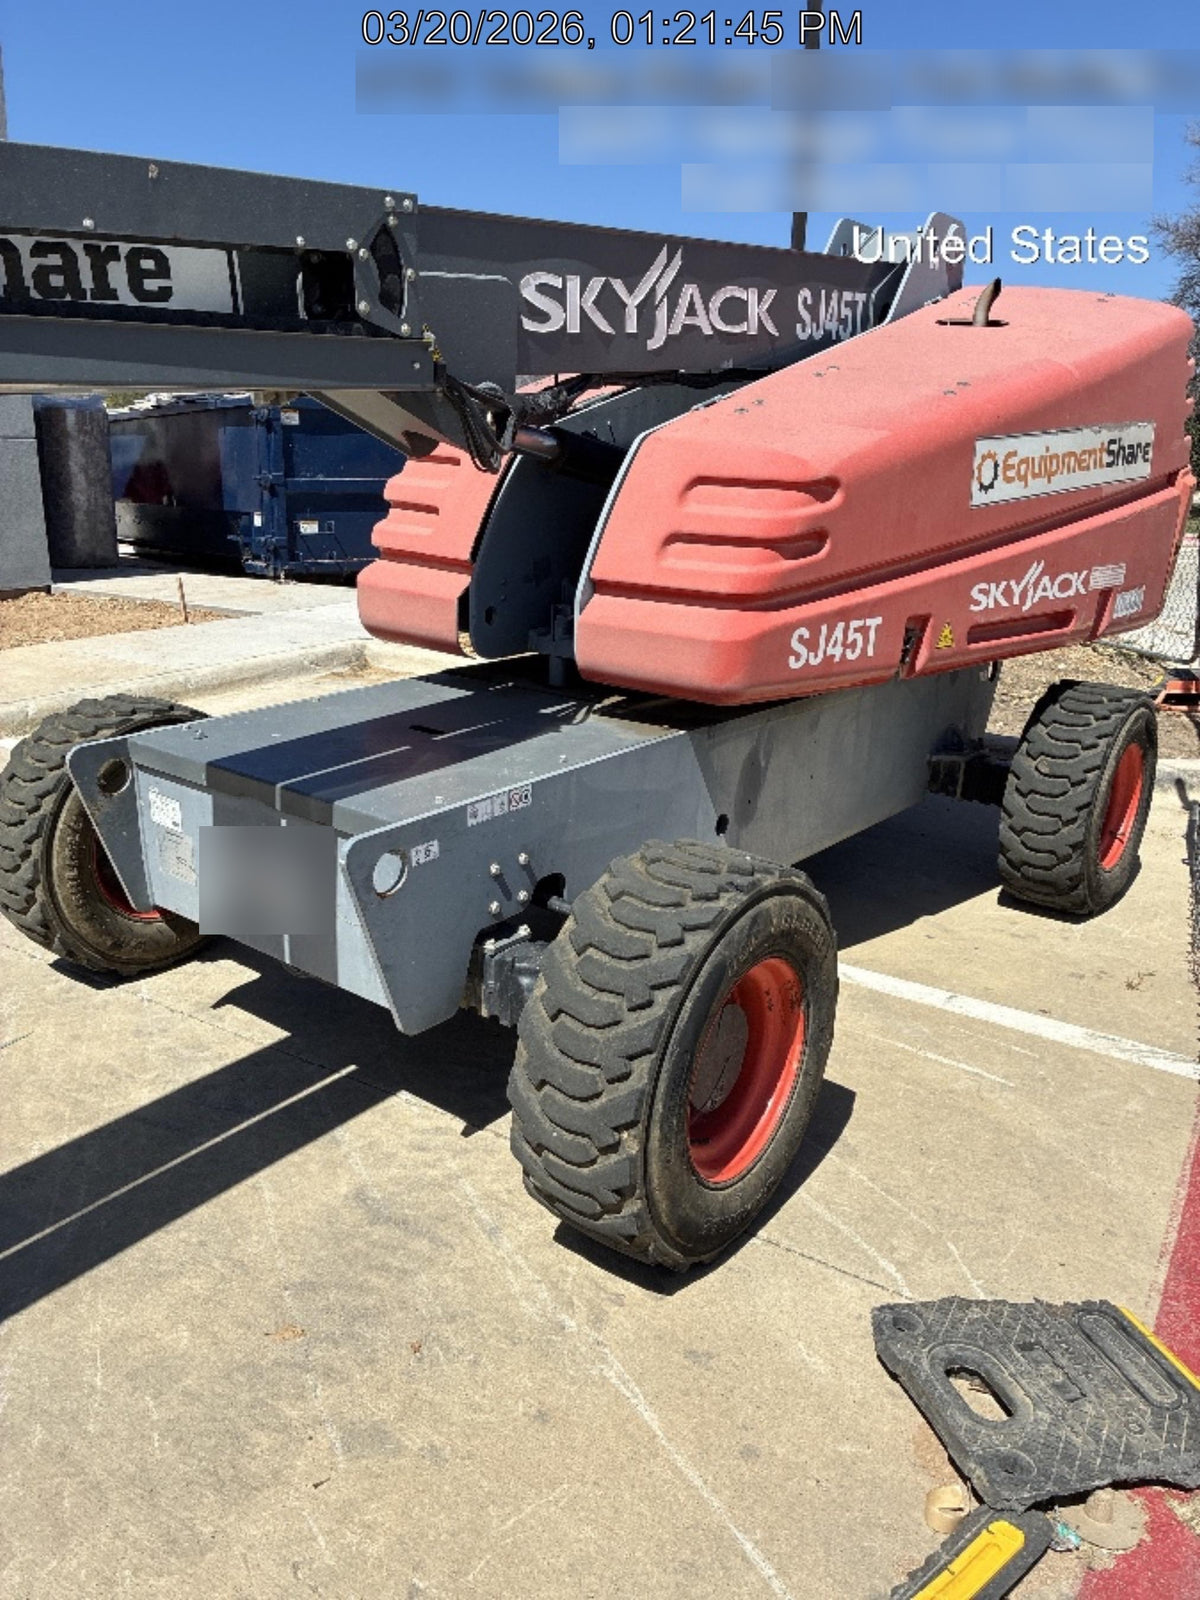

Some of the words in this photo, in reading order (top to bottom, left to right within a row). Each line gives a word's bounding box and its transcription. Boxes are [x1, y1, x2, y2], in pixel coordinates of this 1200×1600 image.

[519, 244, 780, 350] SKYJACK
[796, 287, 867, 340] SJ45T
[1002, 438, 1151, 489] EquipmentShare
[969, 560, 1088, 612] SKYJACK
[788, 616, 882, 669] SJ45T
